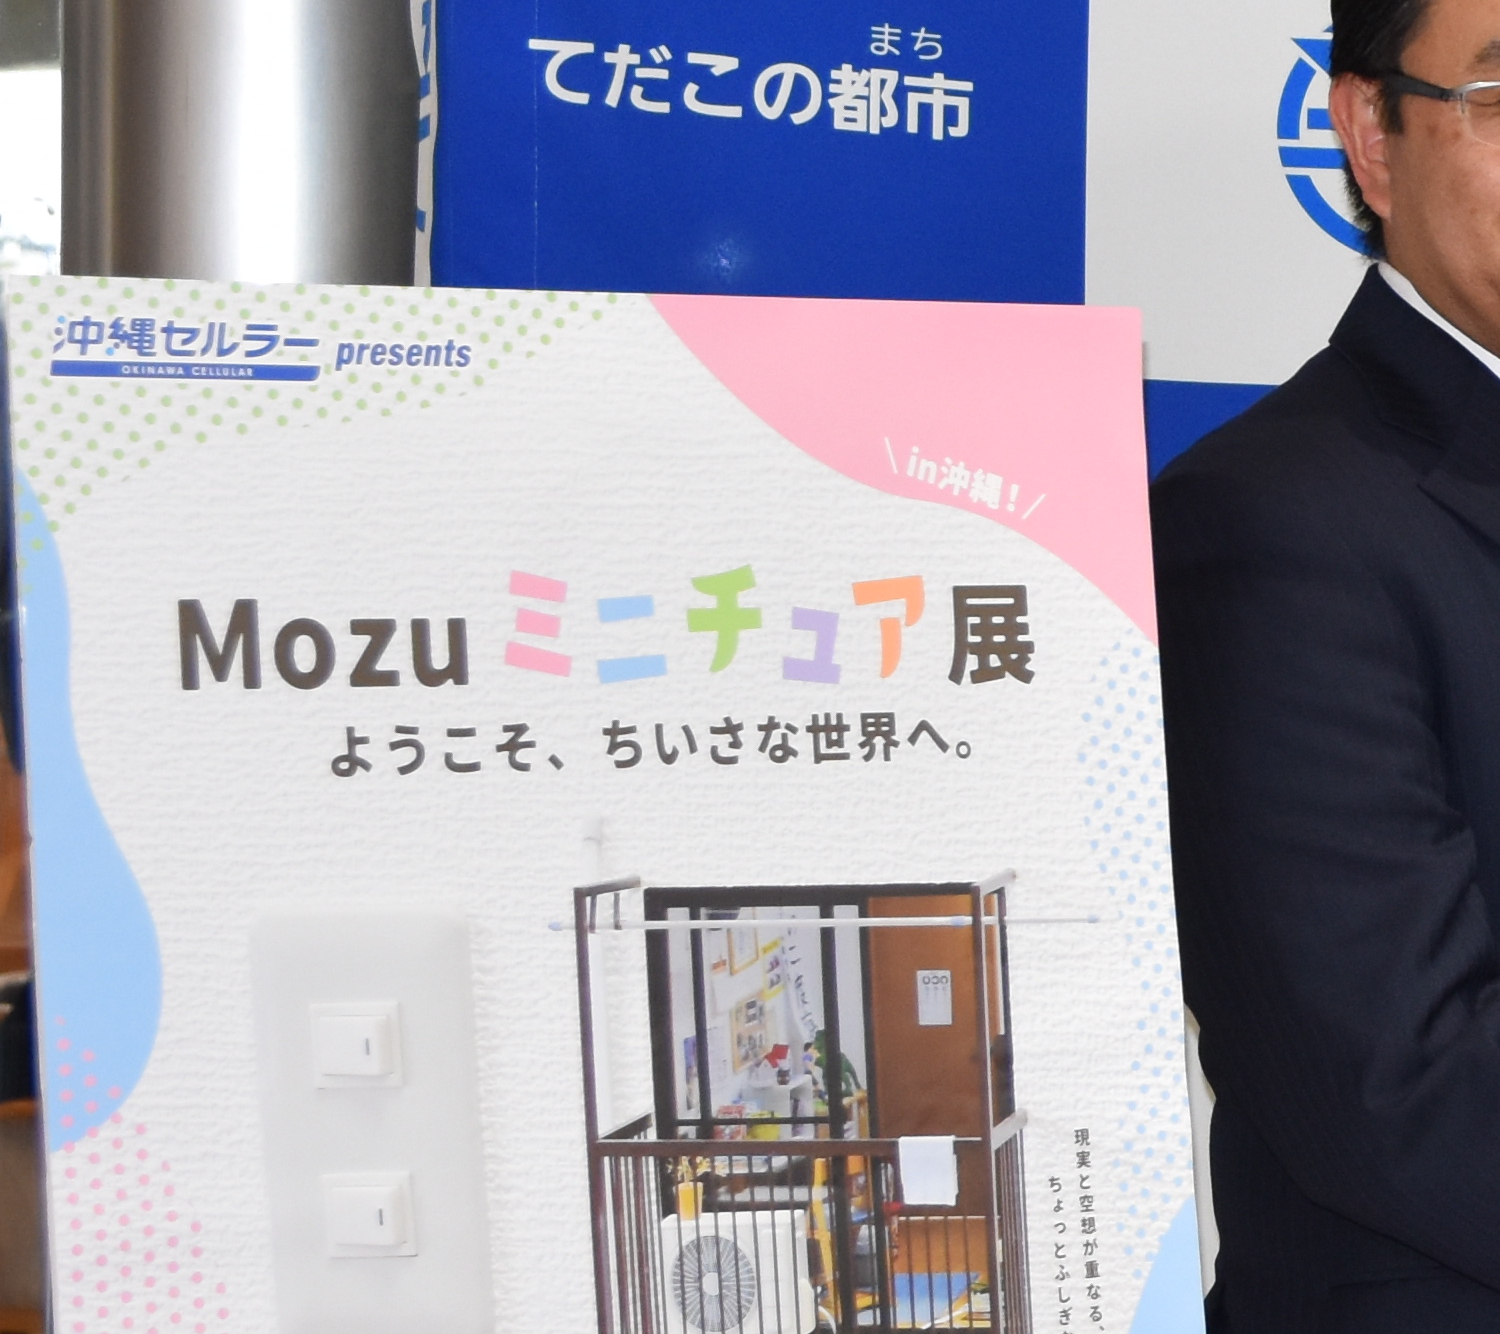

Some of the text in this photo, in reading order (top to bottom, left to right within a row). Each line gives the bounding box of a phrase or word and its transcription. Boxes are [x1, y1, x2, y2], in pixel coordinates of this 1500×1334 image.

[871, 24, 942, 59] まち
[529, 39, 973, 140] てだこの都市
[53, 315, 472, 371] 沖縄セルラー presents
[121, 365, 184, 376] OKINAWA
[177, 565, 1035, 690] Mozu ミニチュア展
[330, 711, 972, 777] ようこそ、ちいさな世界へ。
